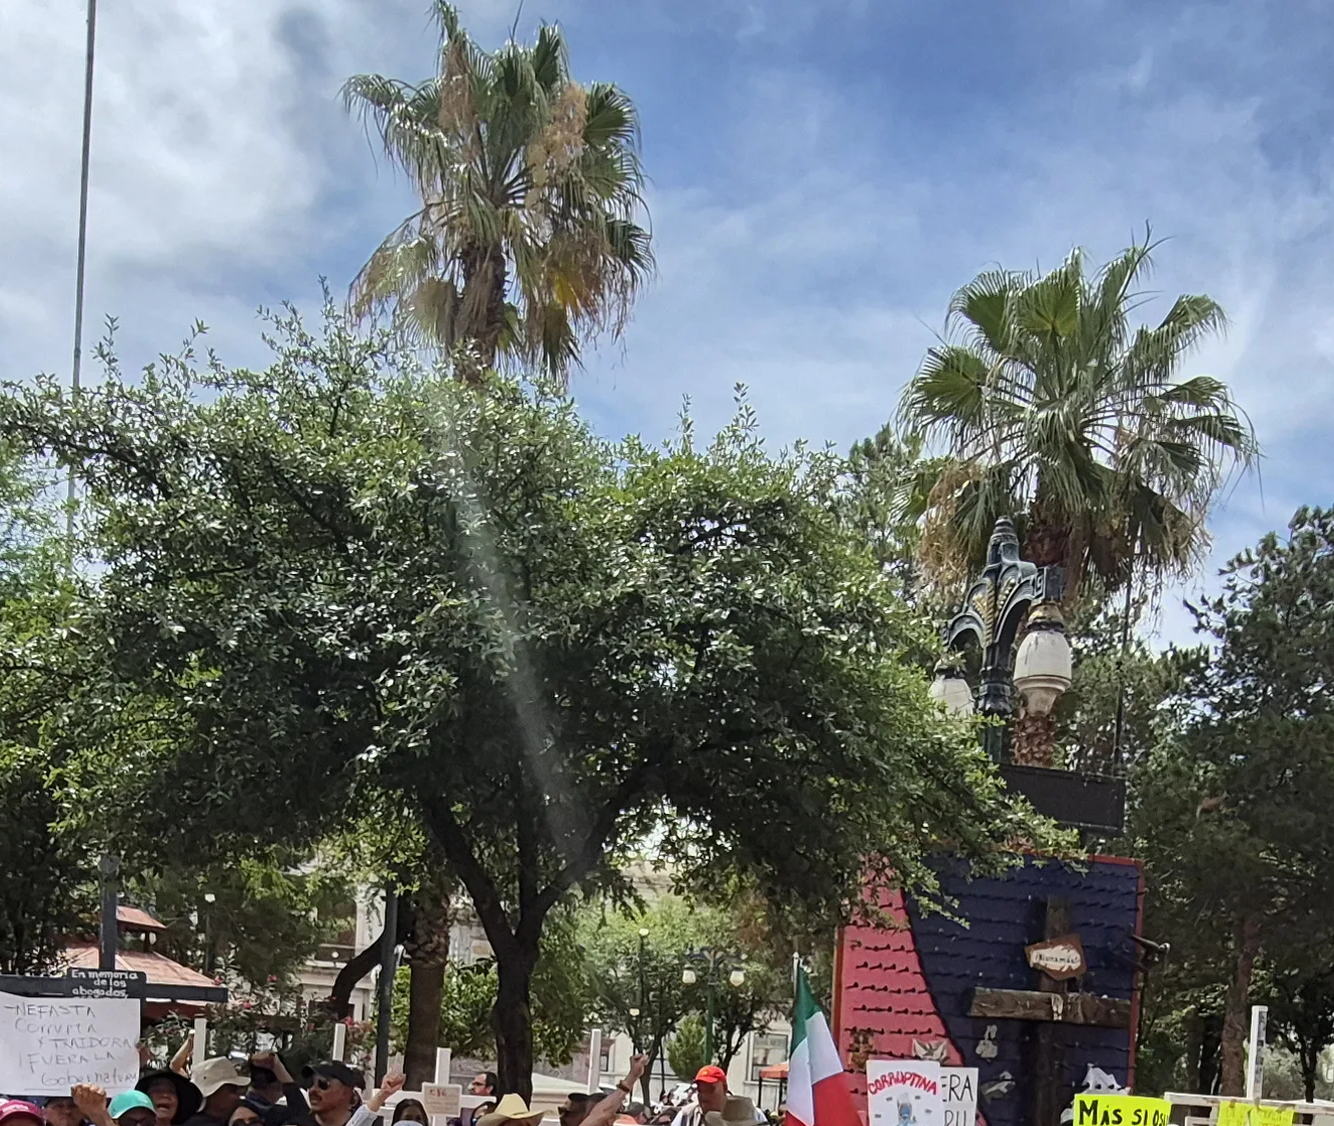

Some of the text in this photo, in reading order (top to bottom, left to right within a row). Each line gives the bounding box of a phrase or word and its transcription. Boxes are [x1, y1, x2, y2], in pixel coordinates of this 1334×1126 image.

[71, 969, 139, 980] En memoria
[93, 977, 127, 987] de los
[868, 1070, 938, 1096] CORRUPTINA
[1131, 1108, 1148, 1126] SI
